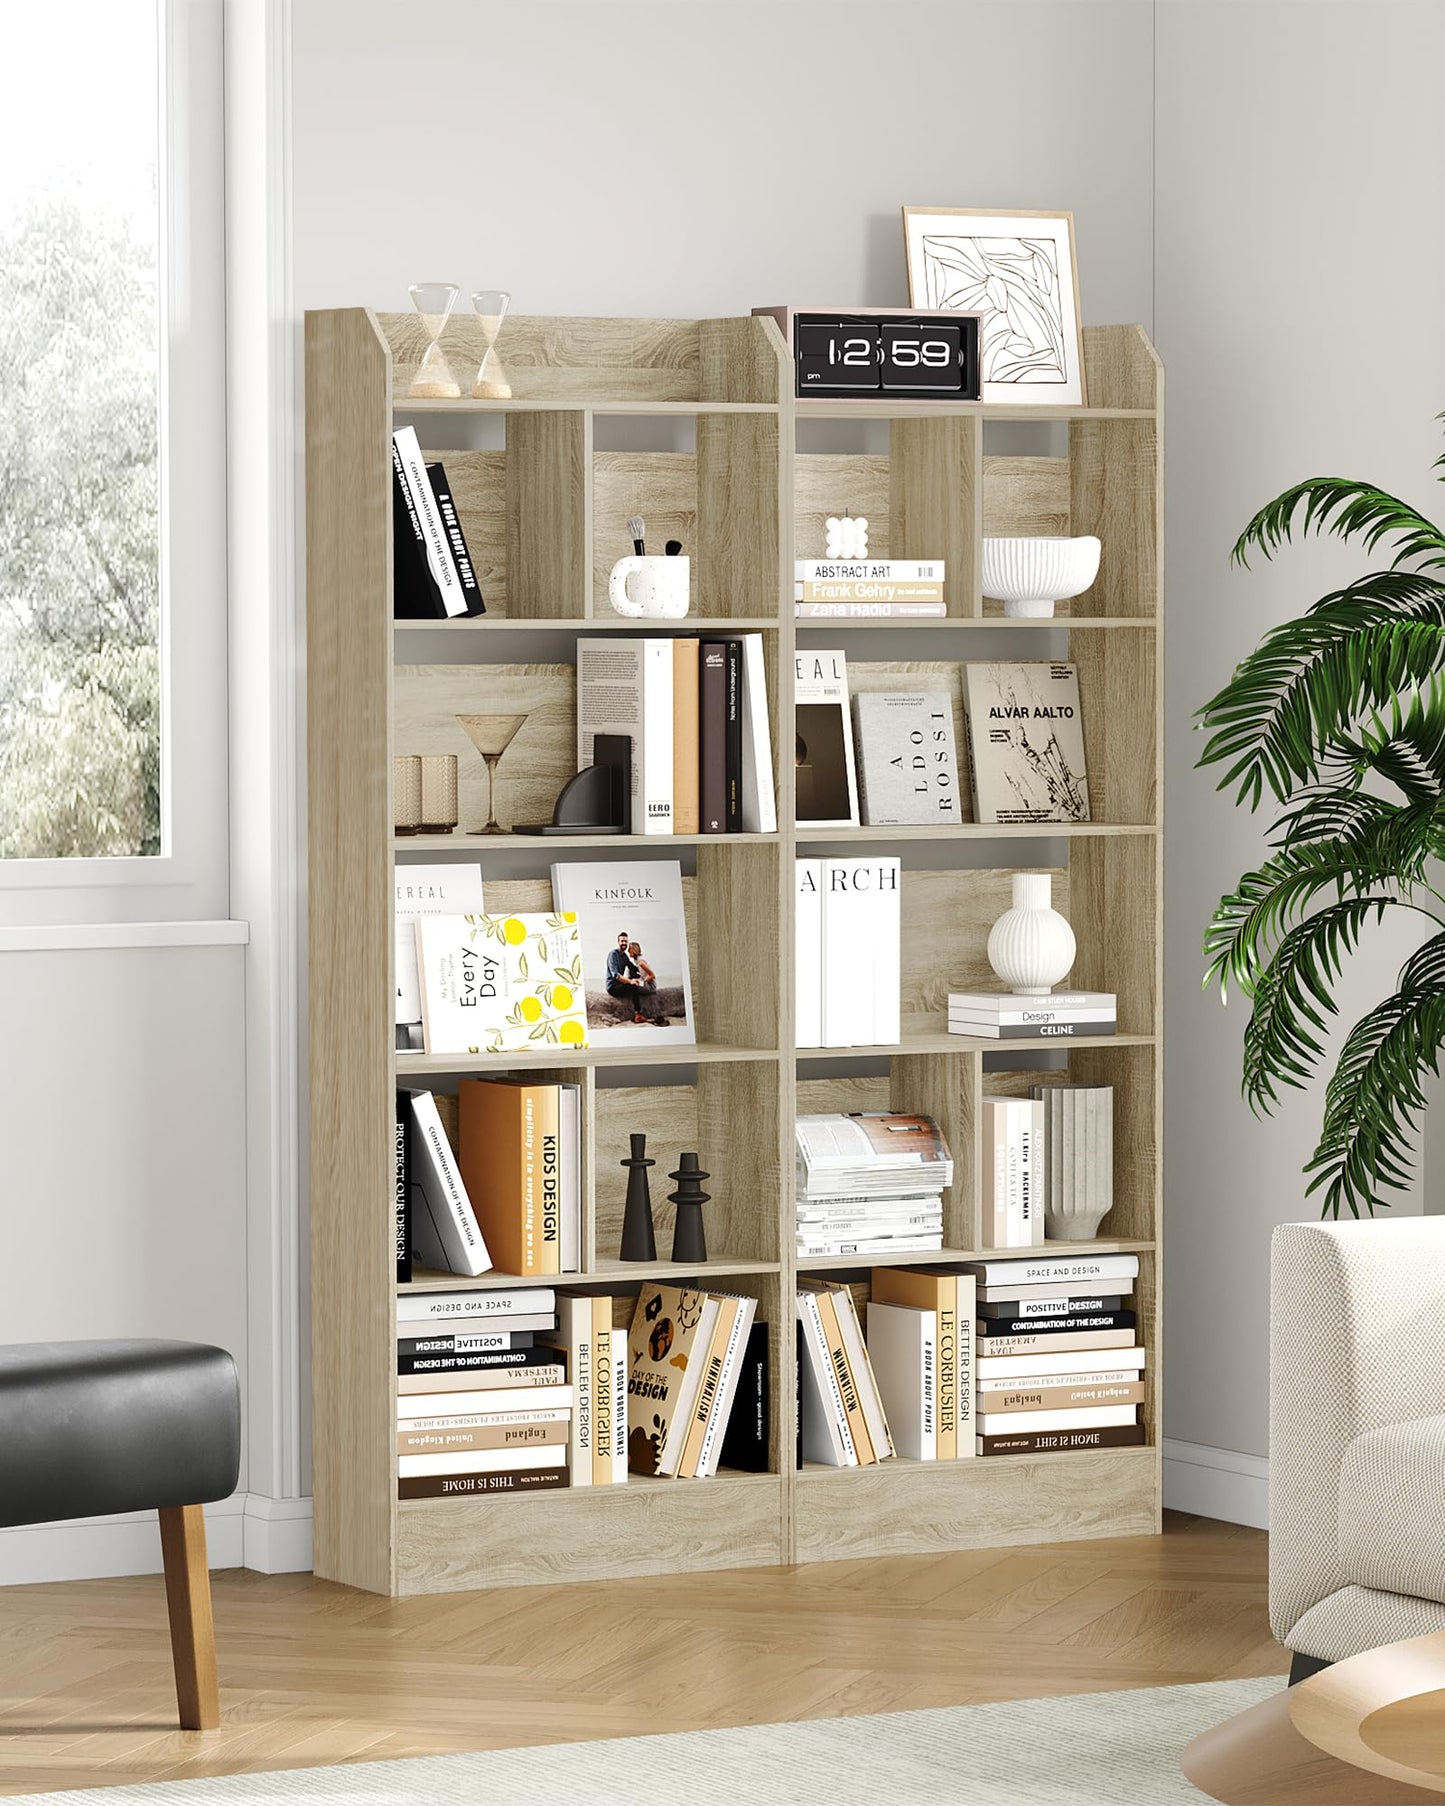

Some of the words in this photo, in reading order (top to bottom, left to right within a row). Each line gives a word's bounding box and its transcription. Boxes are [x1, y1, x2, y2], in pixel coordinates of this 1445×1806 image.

[392, 445, 403, 473] OPEN
[398, 473, 414, 510] DESIGN
[409, 510, 424, 541] NIGHT
[409, 461, 435, 528] CONTAMINATION
[431, 527, 438, 539] OF
[434, 539, 444, 556] THE
[441, 503, 457, 527] BOOK
[449, 528, 467, 556] ABOUT
[458, 558, 476, 589] POINTS
[439, 555, 453, 587] DESIGN
[815, 566, 868, 578] ABSTRACT
[871, 566, 891, 578] ART
[812, 582, 852, 597] Frank
[854, 582, 896, 601] Gehry
[850, 603, 892, 616] Hadid
[989, 707, 1029, 719] ALVAR
[1033, 706, 1074, 719] AALTO
[889, 755, 904, 770] A
[931, 713, 953, 811] ROSSI
[648, 804, 670, 812] EERO
[594, 888, 653, 900] KINFOLK
[460, 947, 479, 1007] Every
[480, 955, 500, 998] Day
[1022, 1012, 1055, 1023] Design
[1040, 1026, 1074, 1035] CELINE
[524, 1098, 535, 1149] simplicity
[396, 1123, 405, 1182] PROTECT
[526, 1151, 533, 1160] is
[543, 1135, 556, 1175] KIDS
[526, 1163, 533, 1173] in
[428, 1126, 455, 1191] CONTAMINATION
[451, 1188, 459, 1201] OF
[455, 1201, 464, 1218] THE
[460, 1216, 475, 1246] DESIGN
[396, 1182, 405, 1215] OUR
[524, 1177, 534, 1231] everything
[543, 1179, 556, 1242] DESIGN
[396, 1215, 405, 1260] DESIGN
[526, 1233, 533, 1246] we
[1026, 1269, 1050, 1278] SPACE
[1053, 1267, 1070, 1276] AND
[1072, 1266, 1100, 1275] DESIGN
[1026, 1302, 1067, 1313] POSITIVE
[1069, 1300, 1102, 1311] DESIGN
[941, 1311, 954, 1331] LE
[1011, 1319, 1066, 1331] CONTAMINATION
[1066, 1319, 1076, 1327] OF
[1076, 1318, 1089, 1326] THE
[1089, 1317, 1113, 1326] DESIGN
[961, 1319, 970, 1367] BETTER
[507, 1367, 558, 1378] SIETSEMA
[631, 1370, 644, 1381] DAY
[645, 1372, 654, 1382] OF
[654, 1373, 668, 1386] THE
[532, 1377, 558, 1385] PAUL
[696, 1355, 722, 1423] MINIMALISM
[941, 1336, 954, 1433] CORBUSIER
[627, 1379, 669, 1401] DESIGN
[961, 1371, 970, 1421] DESIGN
[407, 1436, 444, 1446] Kingdom
[446, 1434, 473, 1443] United
[505, 1429, 546, 1441] England
[442, 1480, 476, 1492] HOME
[478, 1479, 487, 1489] IS
[489, 1476, 514, 1489] THIS
